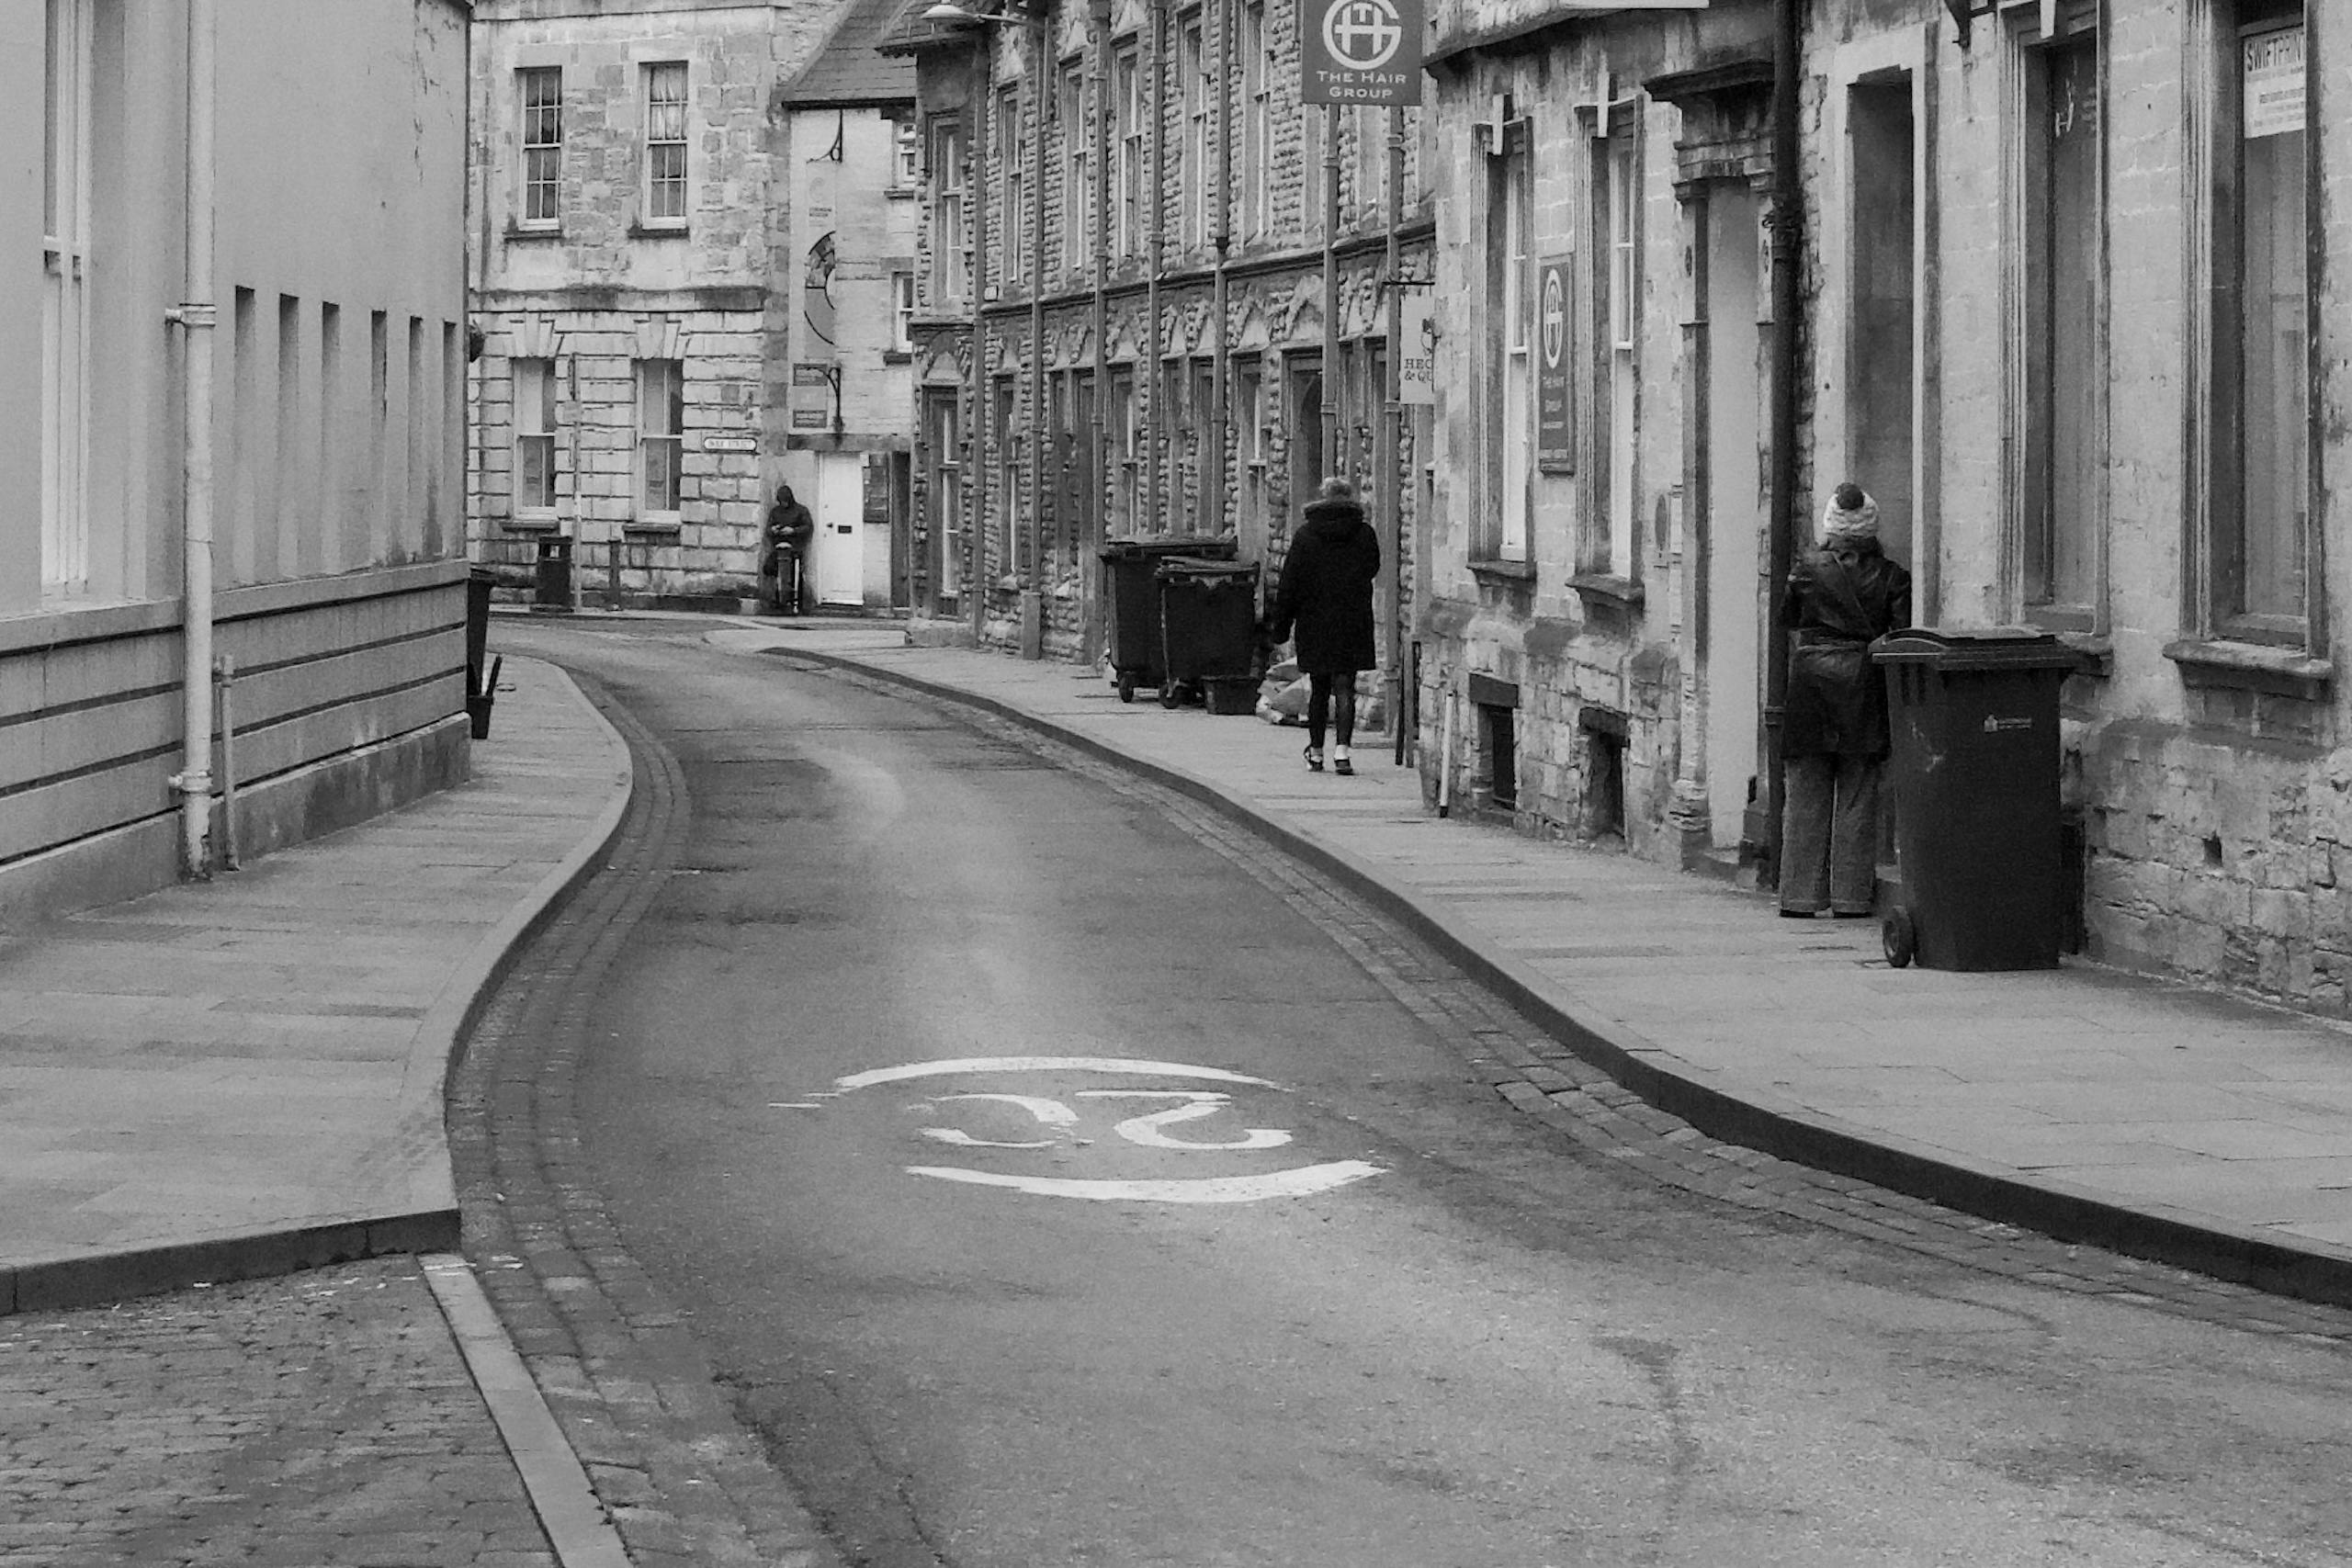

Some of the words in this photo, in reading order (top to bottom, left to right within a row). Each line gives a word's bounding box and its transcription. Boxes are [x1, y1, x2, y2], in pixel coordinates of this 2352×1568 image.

[1316, 71, 1353, 83] THE
[1361, 73, 1407, 85] HAIR
[1329, 86, 1393, 98] GROUP
[1404, 370, 1416, 381] &
